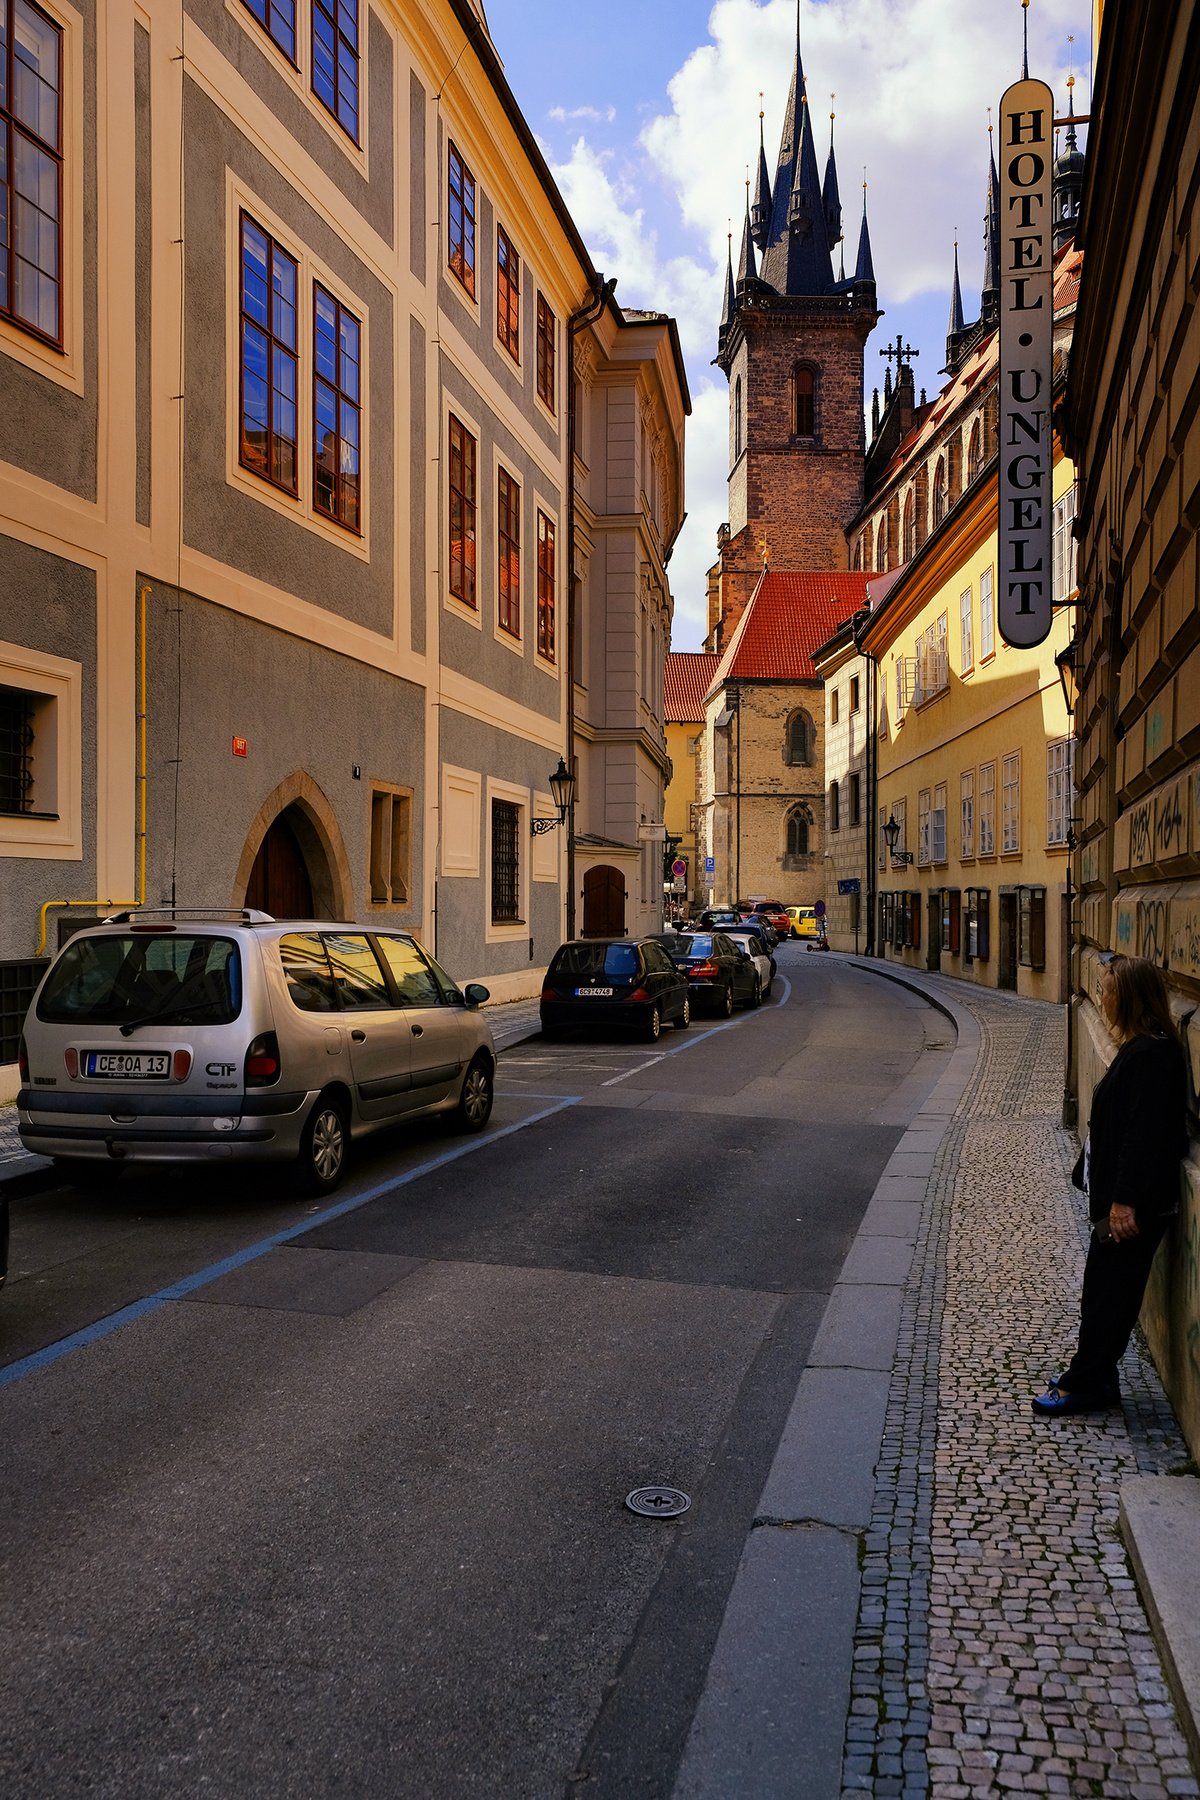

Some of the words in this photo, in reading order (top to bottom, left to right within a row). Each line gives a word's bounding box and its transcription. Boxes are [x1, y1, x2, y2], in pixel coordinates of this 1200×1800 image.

[1006, 109, 1046, 312] HOTEL
[1007, 368, 1046, 616] UNGELT
[100, 1056, 116, 1072] CE
[147, 1057, 165, 1073] 13
